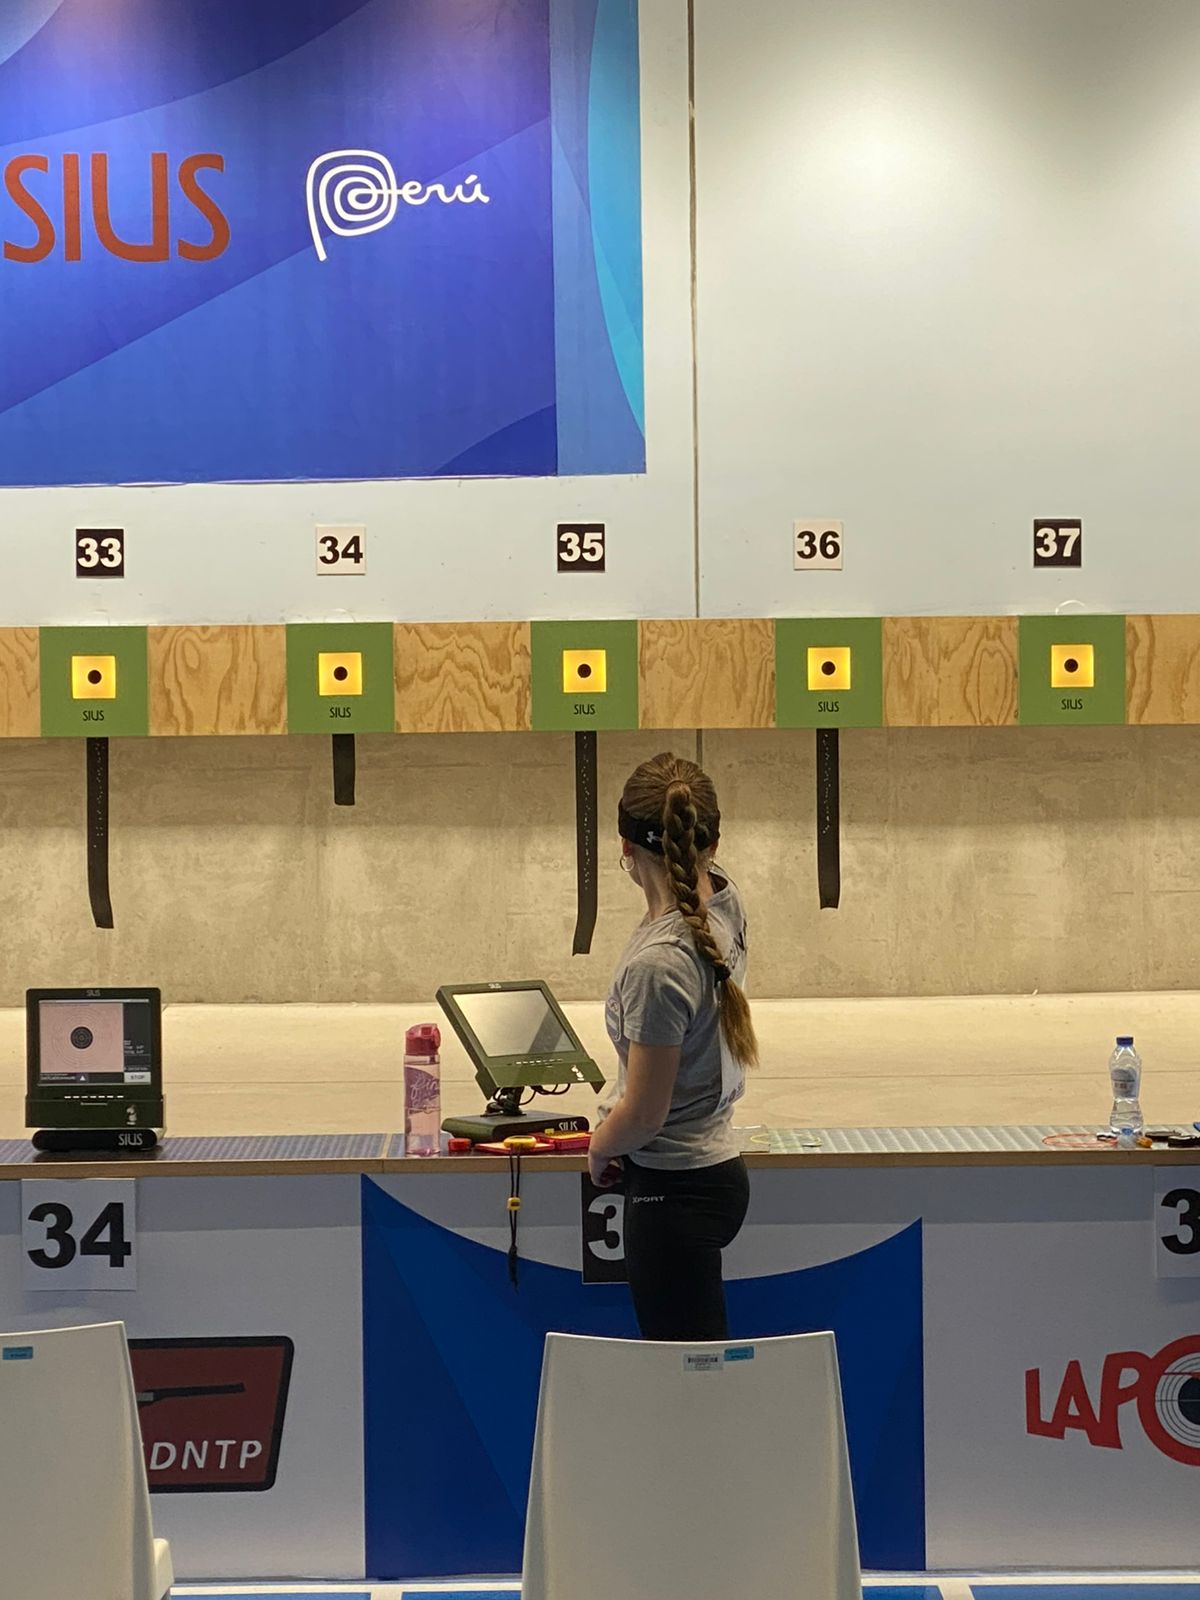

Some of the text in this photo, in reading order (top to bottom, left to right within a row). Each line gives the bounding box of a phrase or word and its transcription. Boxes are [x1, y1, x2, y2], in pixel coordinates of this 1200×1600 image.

[4, 152, 231, 263] SIUS
[306, 149, 490, 262] Perú
[77, 537, 122, 568] 33
[318, 535, 364, 565] 34
[559, 532, 604, 562] 35
[796, 530, 841, 559] 36
[1035, 527, 1081, 557] 37
[82, 710, 105, 721] SIUS
[329, 706, 352, 718] SIUS
[574, 703, 596, 715] SIUS
[817, 701, 840, 712] SIUS
[1061, 698, 1083, 710] SIUS
[118, 1133, 143, 1146] SIUS
[27, 1202, 132, 1268] 34
[588, 1193, 625, 1261] 3
[1160, 1188, 1200, 1255] 3
[141, 1440, 263, 1470] DNTP
